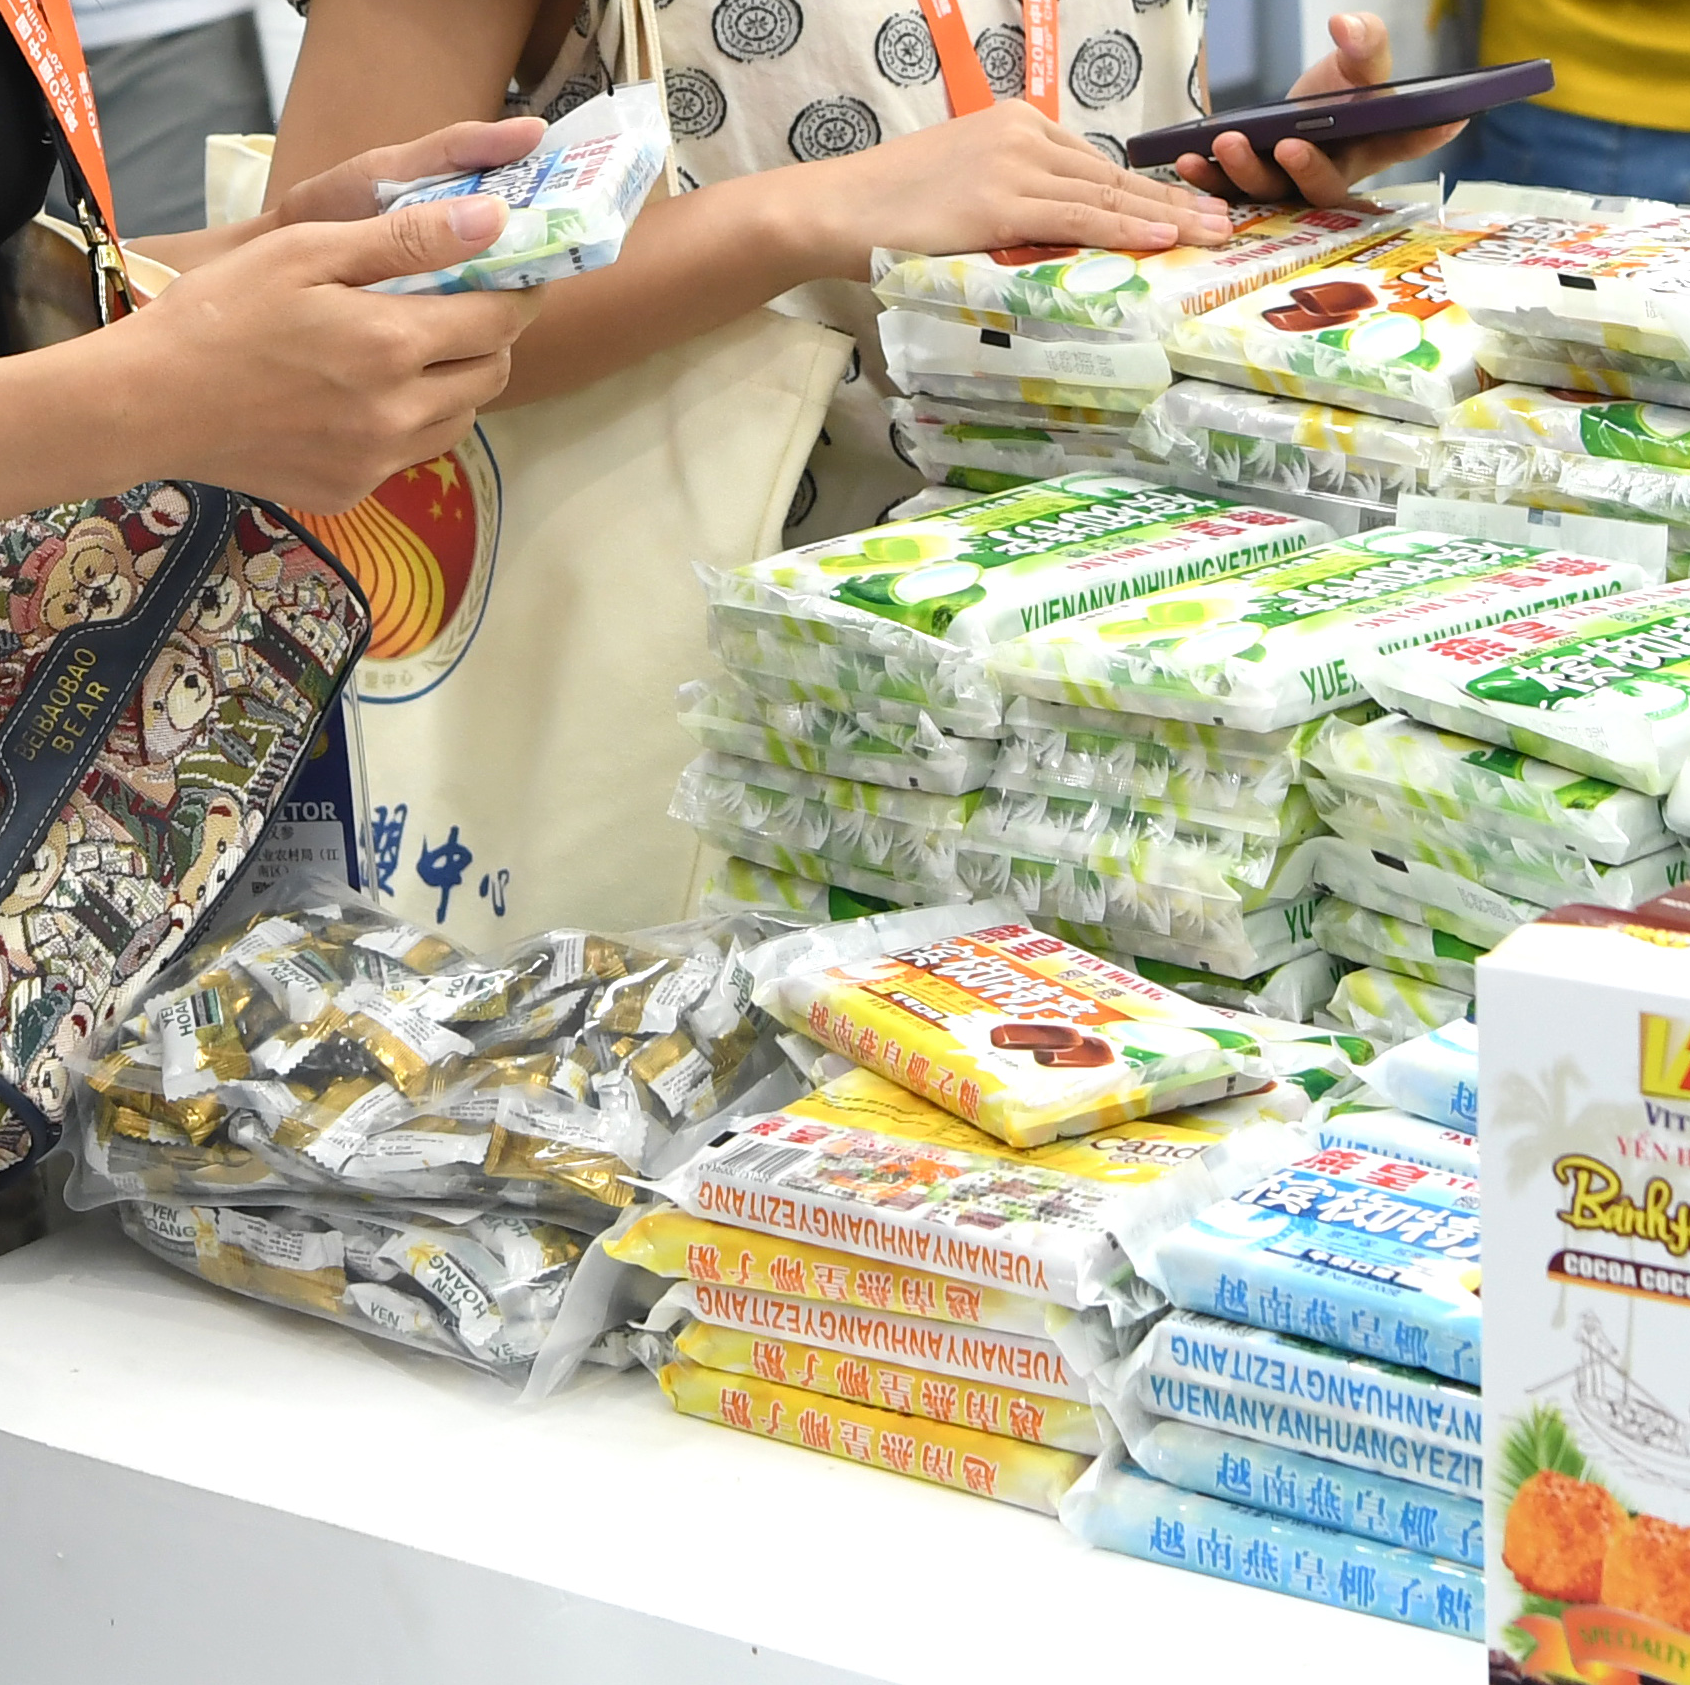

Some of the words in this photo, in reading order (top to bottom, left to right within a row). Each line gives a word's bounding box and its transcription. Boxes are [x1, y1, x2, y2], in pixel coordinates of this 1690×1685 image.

[60, 72, 78, 109] THE
[13, 647, 97, 761] BEIBAOBAO
[51, 681, 111, 754] BEAR
[808, 1000, 982, 1122] 越南燕皇椰子糖
[1089, 1135, 1210, 1160] Cand
[685, 1242, 984, 1324] 越南燕皇椰子糖
[697, 1179, 1051, 1292] YUENANYANHUANGYEZITANG
[1563, 1252, 1639, 1290] COCOA
[695, 1283, 1070, 1387] YUENANYANHUANGYEZITANG
[718, 1386, 1000, 1497] 越南燕皇椰子糖
[751, 1339, 1047, 1443] 越南燕皇椰子糖
[1148, 1515, 1476, 1633] 越南燕皇椰子糖
